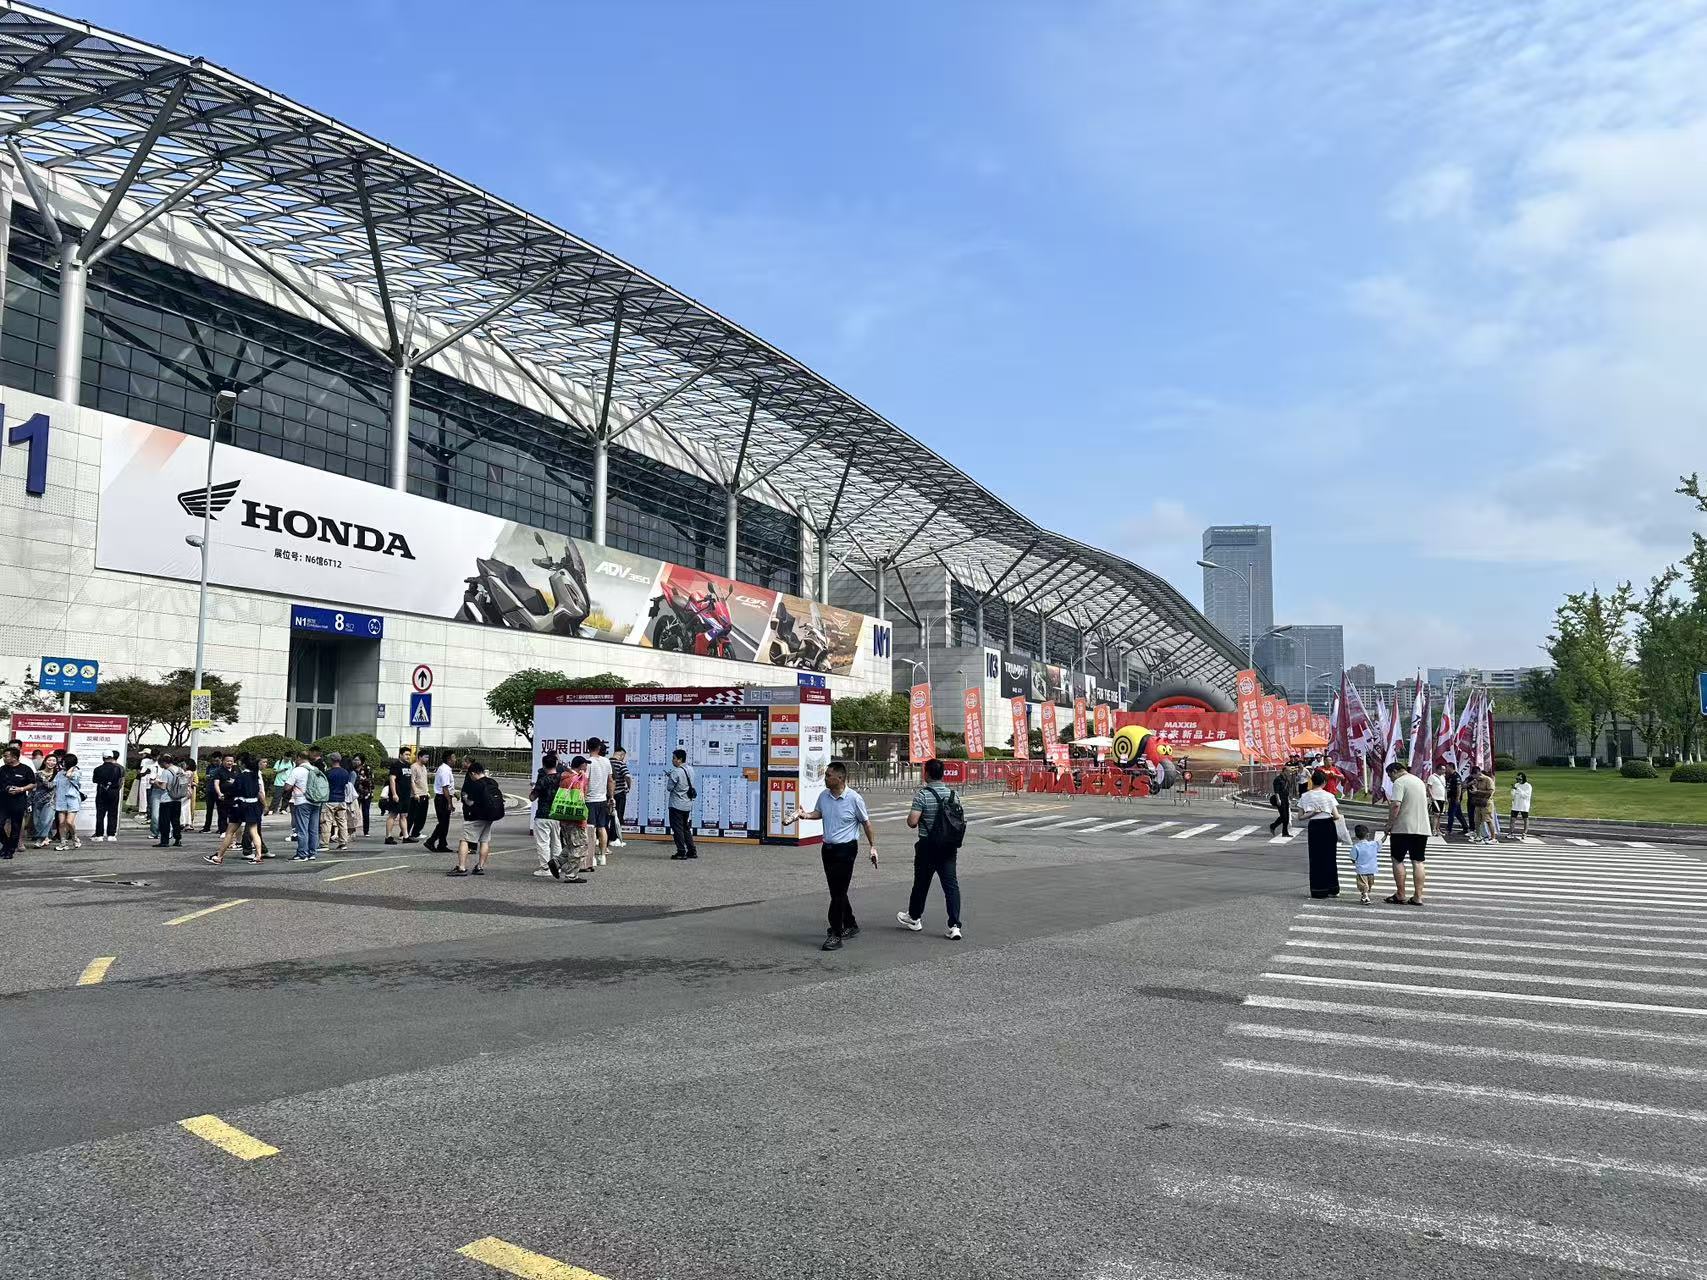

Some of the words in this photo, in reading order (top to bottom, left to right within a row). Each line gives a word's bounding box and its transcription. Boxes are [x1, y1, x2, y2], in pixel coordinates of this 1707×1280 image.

[0, 403, 50, 498] 1
[241, 499, 416, 560] HONDA
[595, 561, 632, 578] ADV
[628, 573, 651, 585] 350
[295, 616, 307, 627] N1
[335, 613, 344, 631] 8
[873, 624, 891, 659] N1
[986, 652, 998, 679] N3
[1164, 721, 1198, 729] MAXXIS
[1182, 729, 1227, 739] 新品上市
[1026, 771, 1151, 797] MAXXIS
